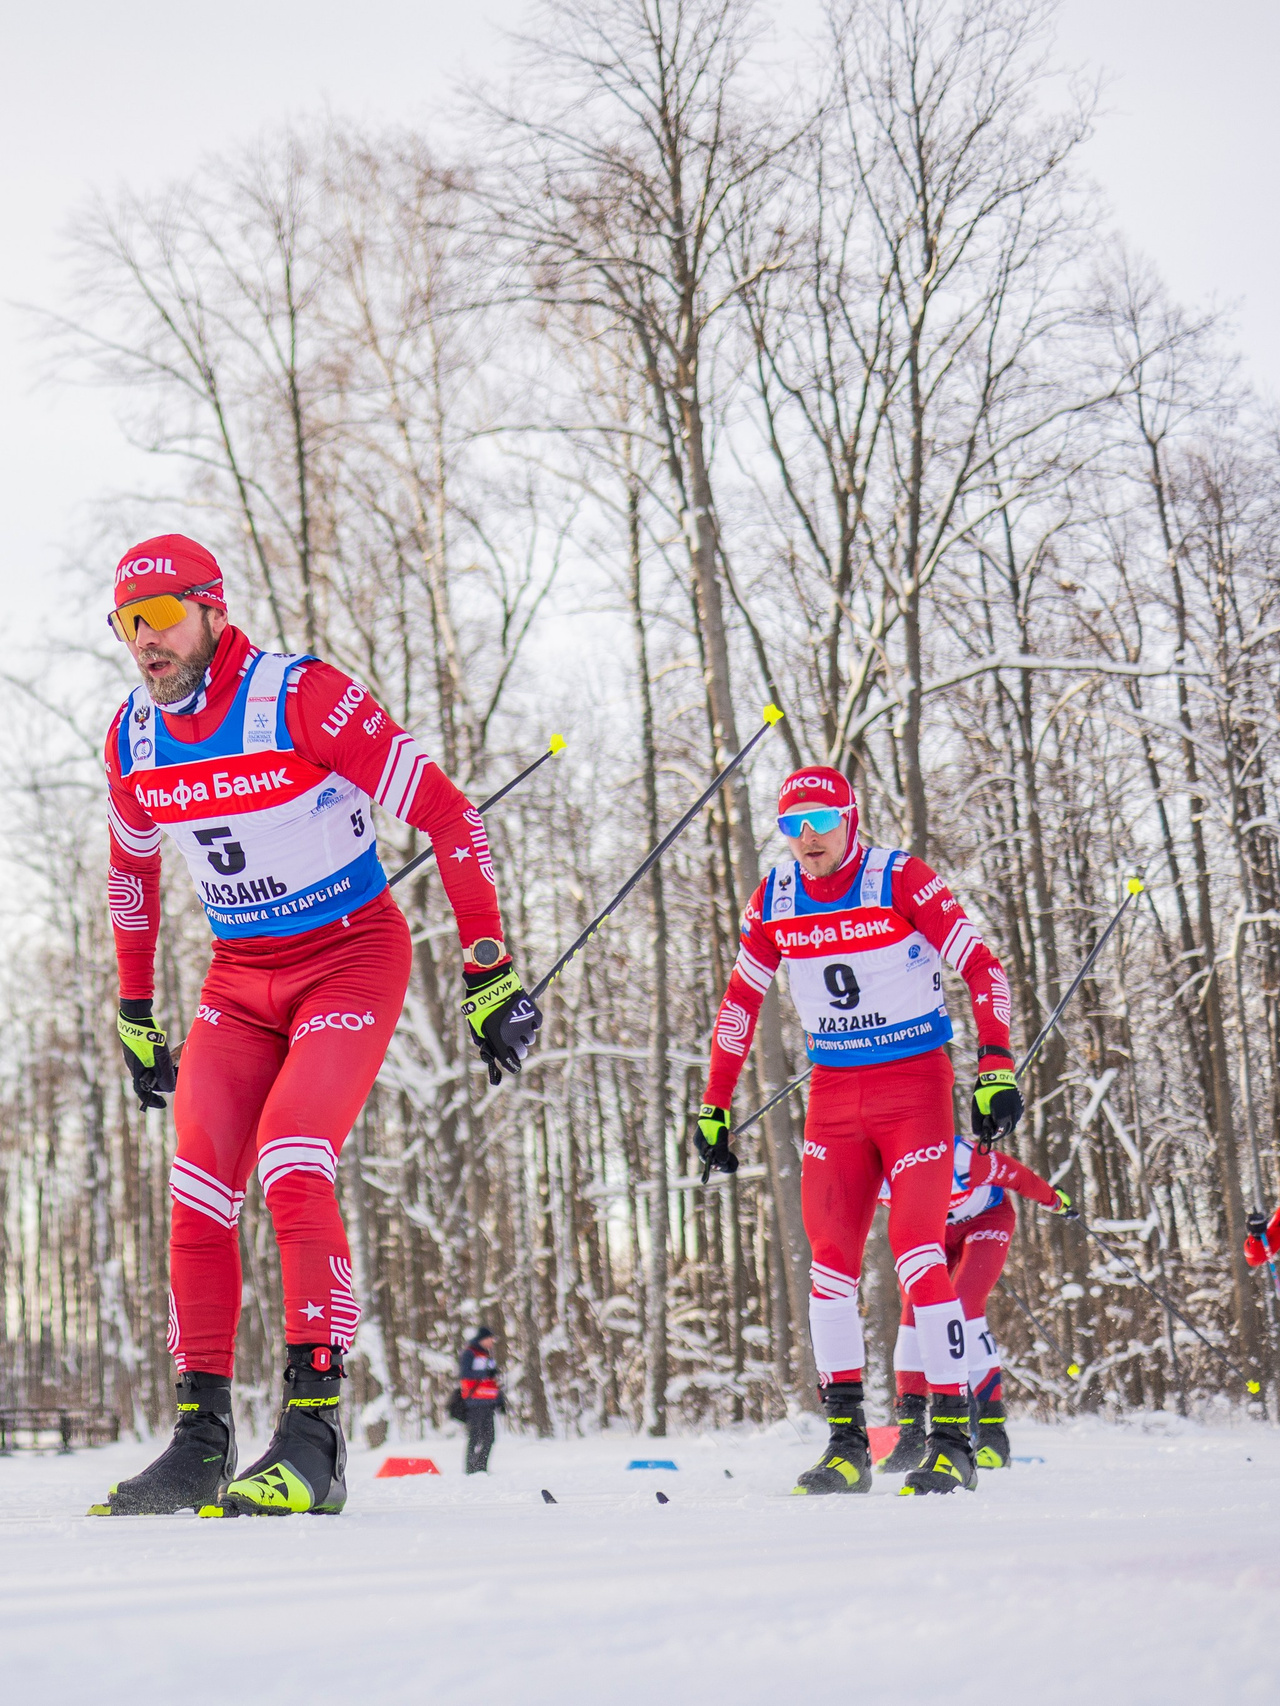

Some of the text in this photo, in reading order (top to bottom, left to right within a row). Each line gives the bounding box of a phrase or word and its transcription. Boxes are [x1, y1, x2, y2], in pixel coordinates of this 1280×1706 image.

[135, 767, 295, 811] Альфа Банк
[350, 808, 365, 838] 5
[192, 826, 247, 876] 5
[271, 876, 352, 917] ТАТАРСТАН
[775, 918, 895, 949] Альфа Банк
[823, 963, 860, 1010] 9
[932, 971, 941, 992] 9
[815, 1022, 933, 1051] РЕСПУБЛИКА ТАТАРСТАН
[947, 1319, 965, 1359] 9
